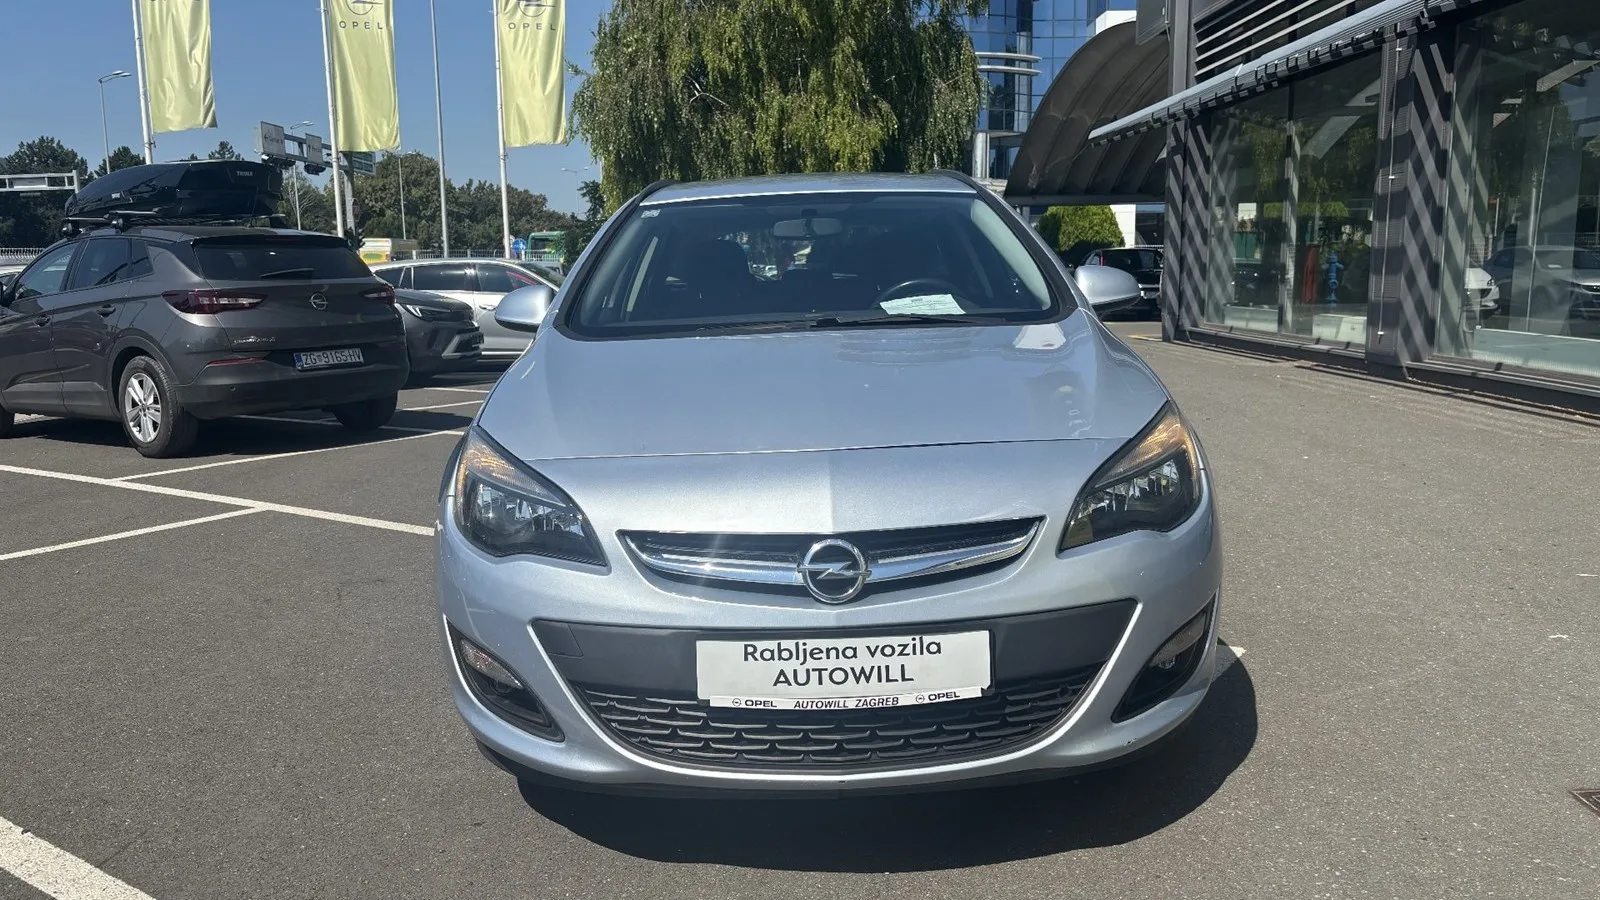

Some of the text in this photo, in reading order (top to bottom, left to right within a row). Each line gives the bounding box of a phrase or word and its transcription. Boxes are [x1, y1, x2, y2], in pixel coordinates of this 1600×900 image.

[339, 20, 383, 30] OPEL
[508, 22, 557, 31] OPEL
[743, 635, 942, 666] Rabljena vozila
[772, 664, 915, 687] AUTOWILL
[744, 691, 961, 709] OPEL AUTOWILL ZAGREB OPEL
